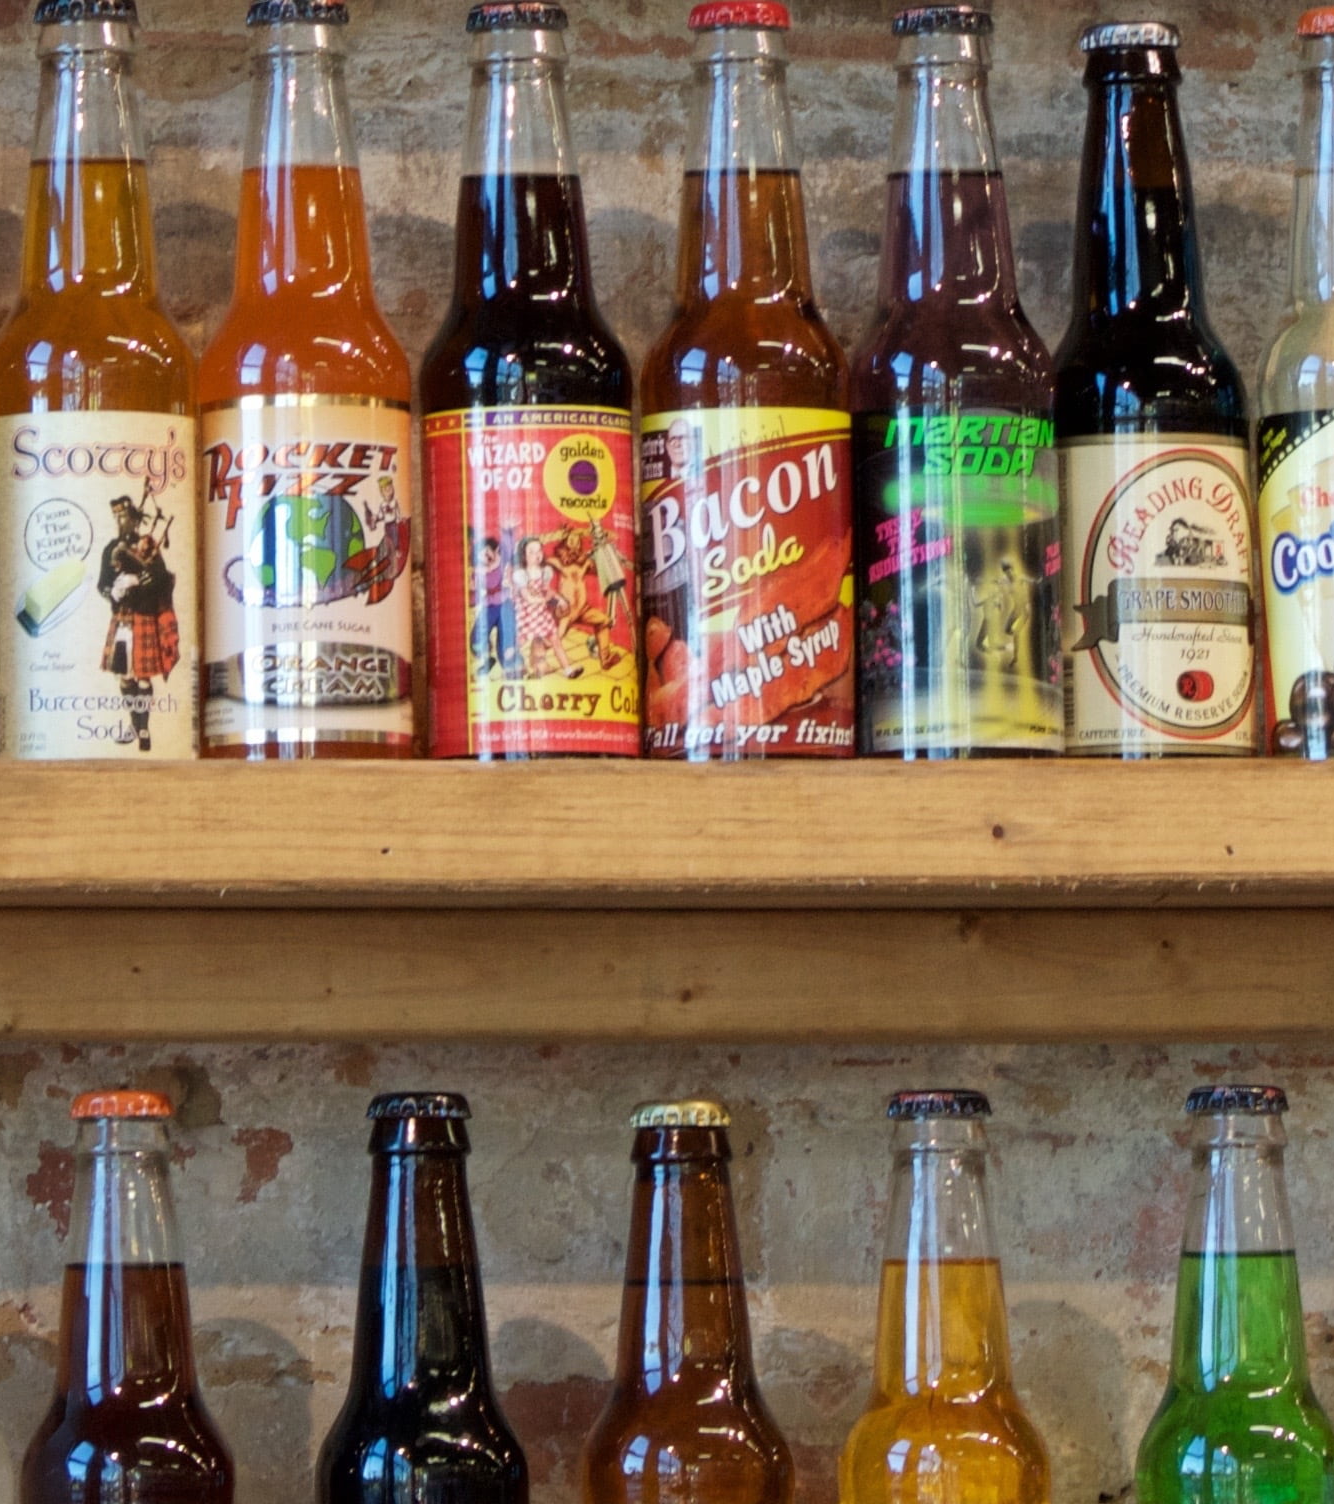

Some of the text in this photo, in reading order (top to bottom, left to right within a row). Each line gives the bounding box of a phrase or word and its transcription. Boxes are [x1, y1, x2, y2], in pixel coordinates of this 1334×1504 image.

[469, 440, 543, 469] WIZARD
[559, 442, 605, 462] golden
[479, 467, 534, 487] OF OZ
[559, 493, 607, 511] records
[1178, 647, 1211, 660] 1921
[498, 683, 601, 719] Cherry
